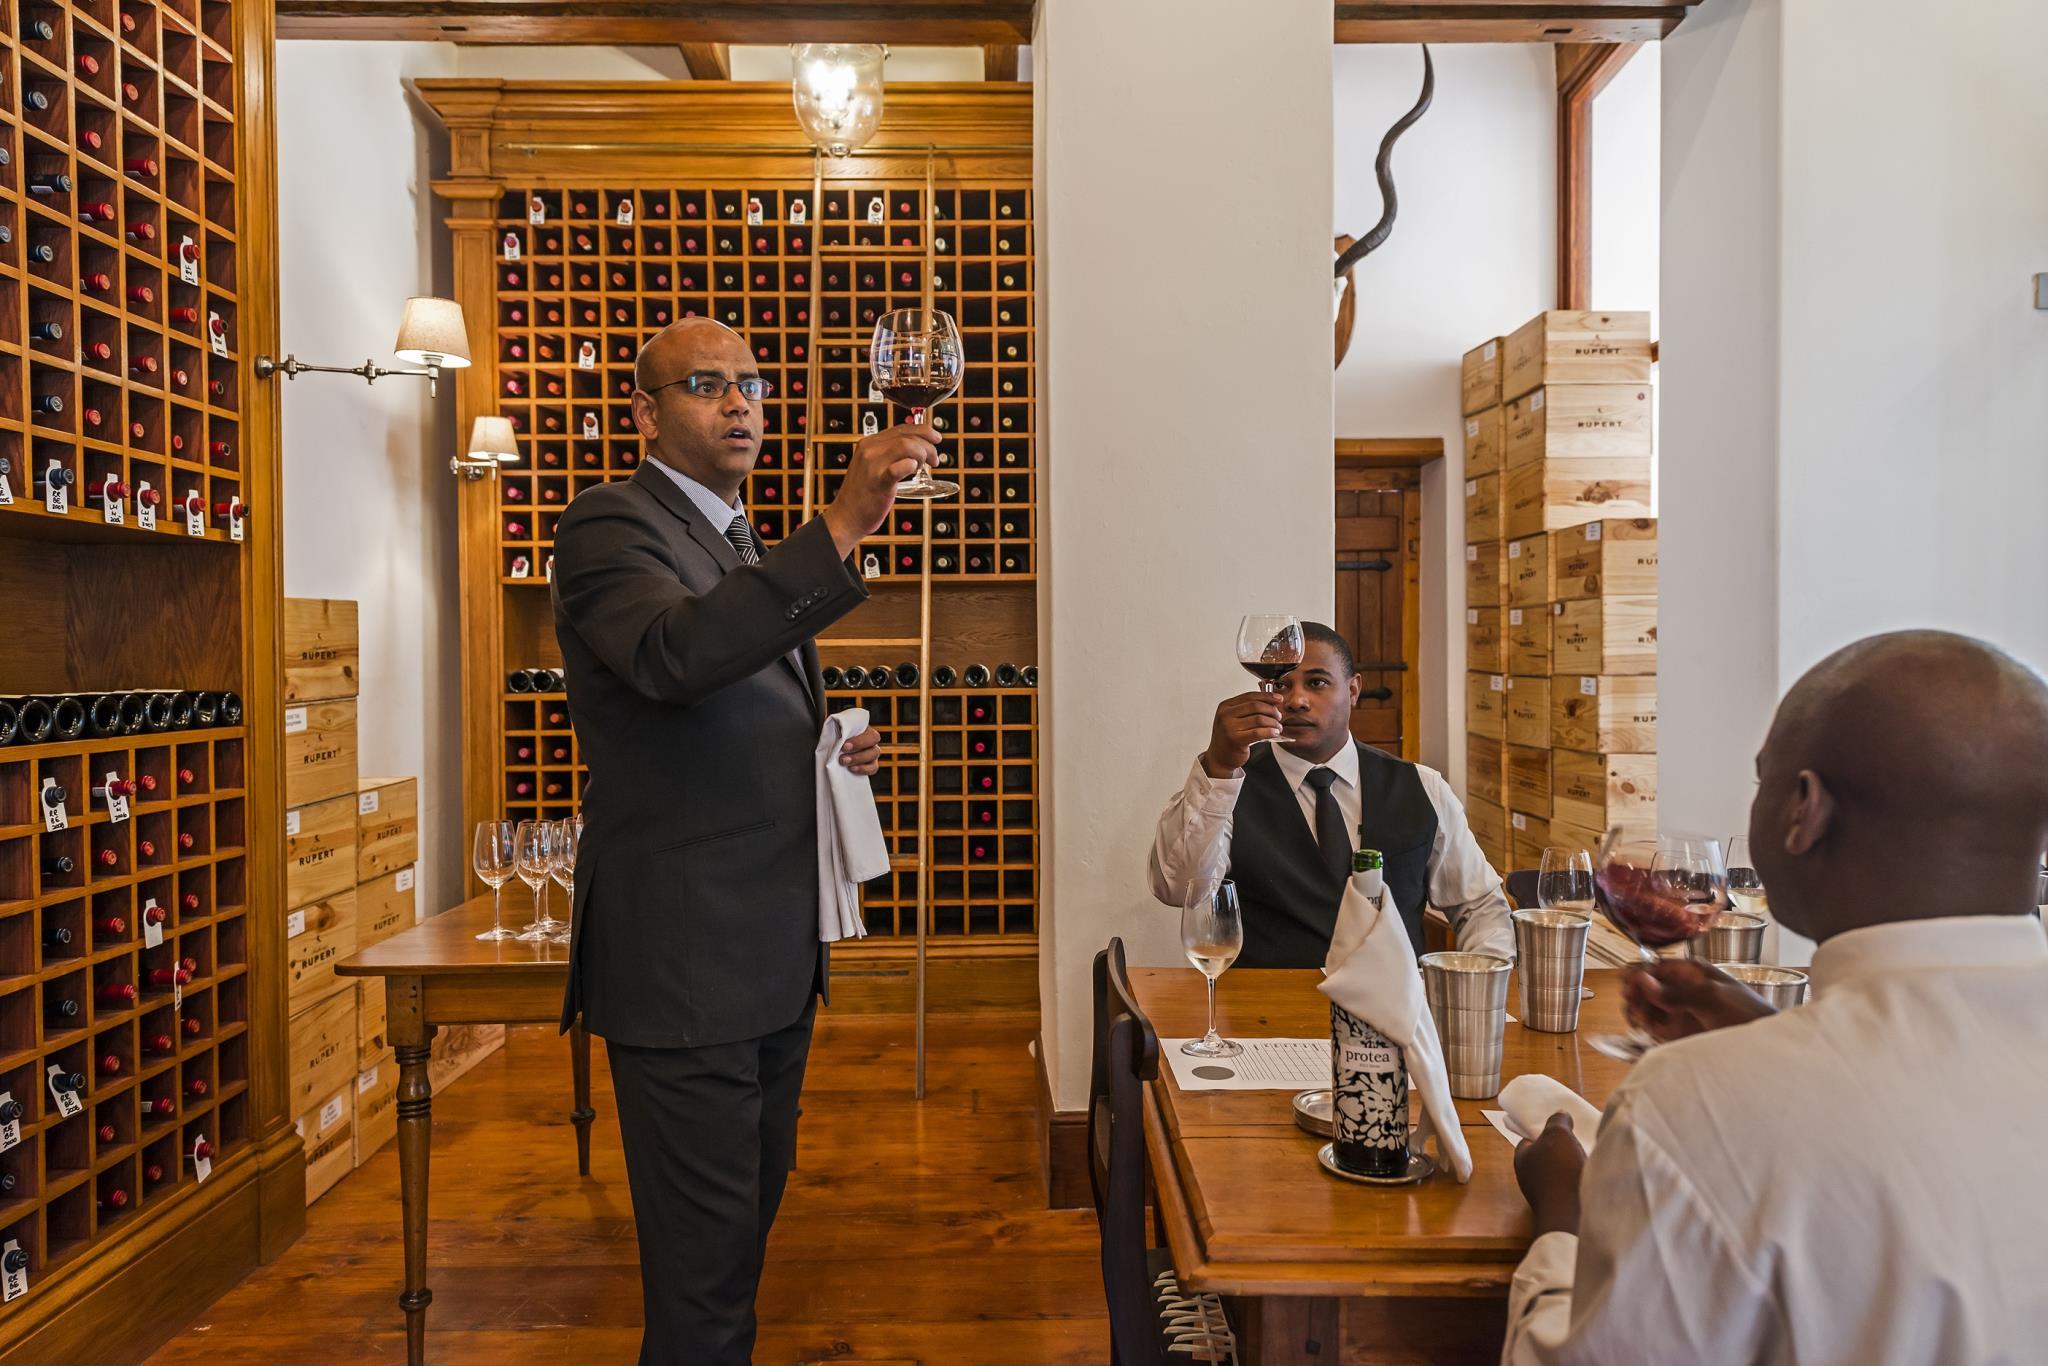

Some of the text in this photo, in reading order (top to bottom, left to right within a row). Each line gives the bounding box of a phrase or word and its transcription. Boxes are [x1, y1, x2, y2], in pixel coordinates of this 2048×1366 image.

[1577, 420, 1623, 428] RUPERT
[302, 651, 337, 661] RUPERT
[303, 750, 338, 765] RUPERT
[377, 826, 402, 840] RUPERT
[299, 848, 335, 866] RUPERT
[373, 914, 400, 931] RUPERT
[302, 947, 336, 969] RUPERT
[309, 1042, 341, 1069] RUPERT
[1345, 1050, 1390, 1063] protea
